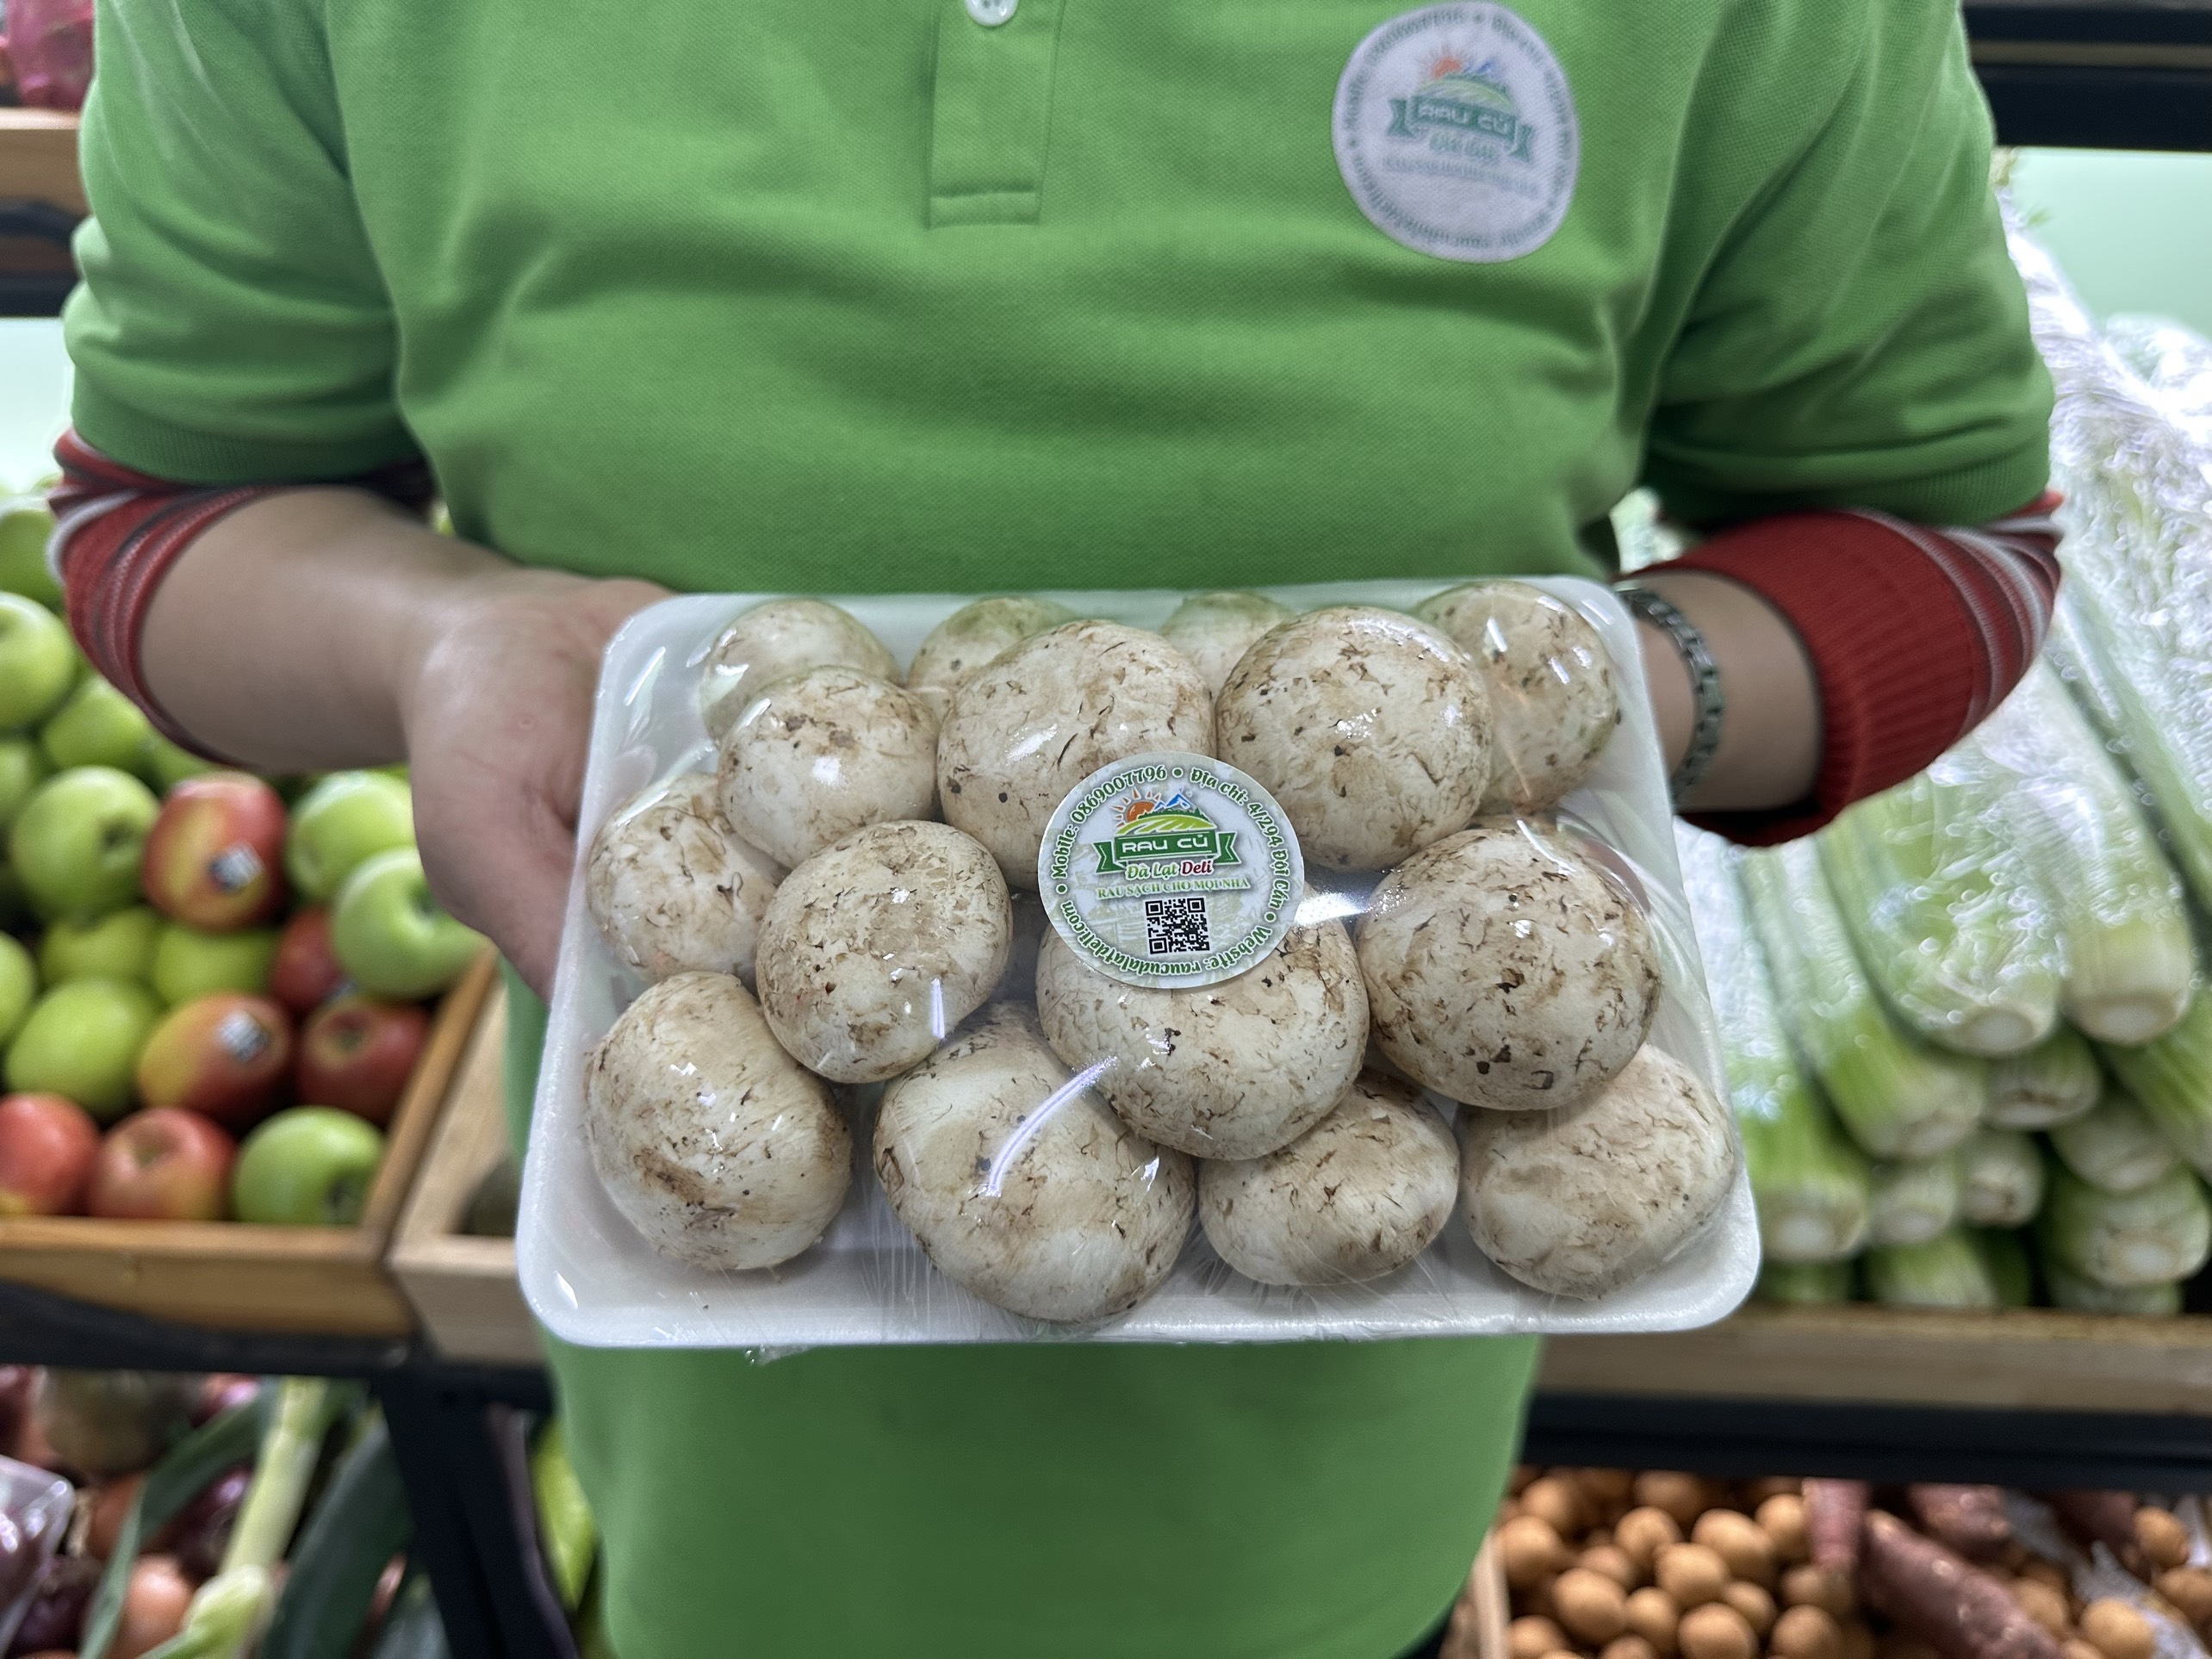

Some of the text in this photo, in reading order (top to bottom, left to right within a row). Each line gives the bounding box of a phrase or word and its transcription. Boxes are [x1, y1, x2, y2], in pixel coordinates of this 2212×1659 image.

[1053, 766, 1166, 879] Mobile: 0869007796
[1248, 803, 1283, 848] 4/294
[1122, 834, 1209, 854] RAU CỦ
[1127, 860, 1213, 879] Đà Lạt Deli
[1098, 887, 1122, 898] RAU
[1127, 883, 1160, 897] SẠCH
[1163, 880, 1191, 892] CHO
[1060, 900, 1272, 975] Website: raucudalatdeli.com
